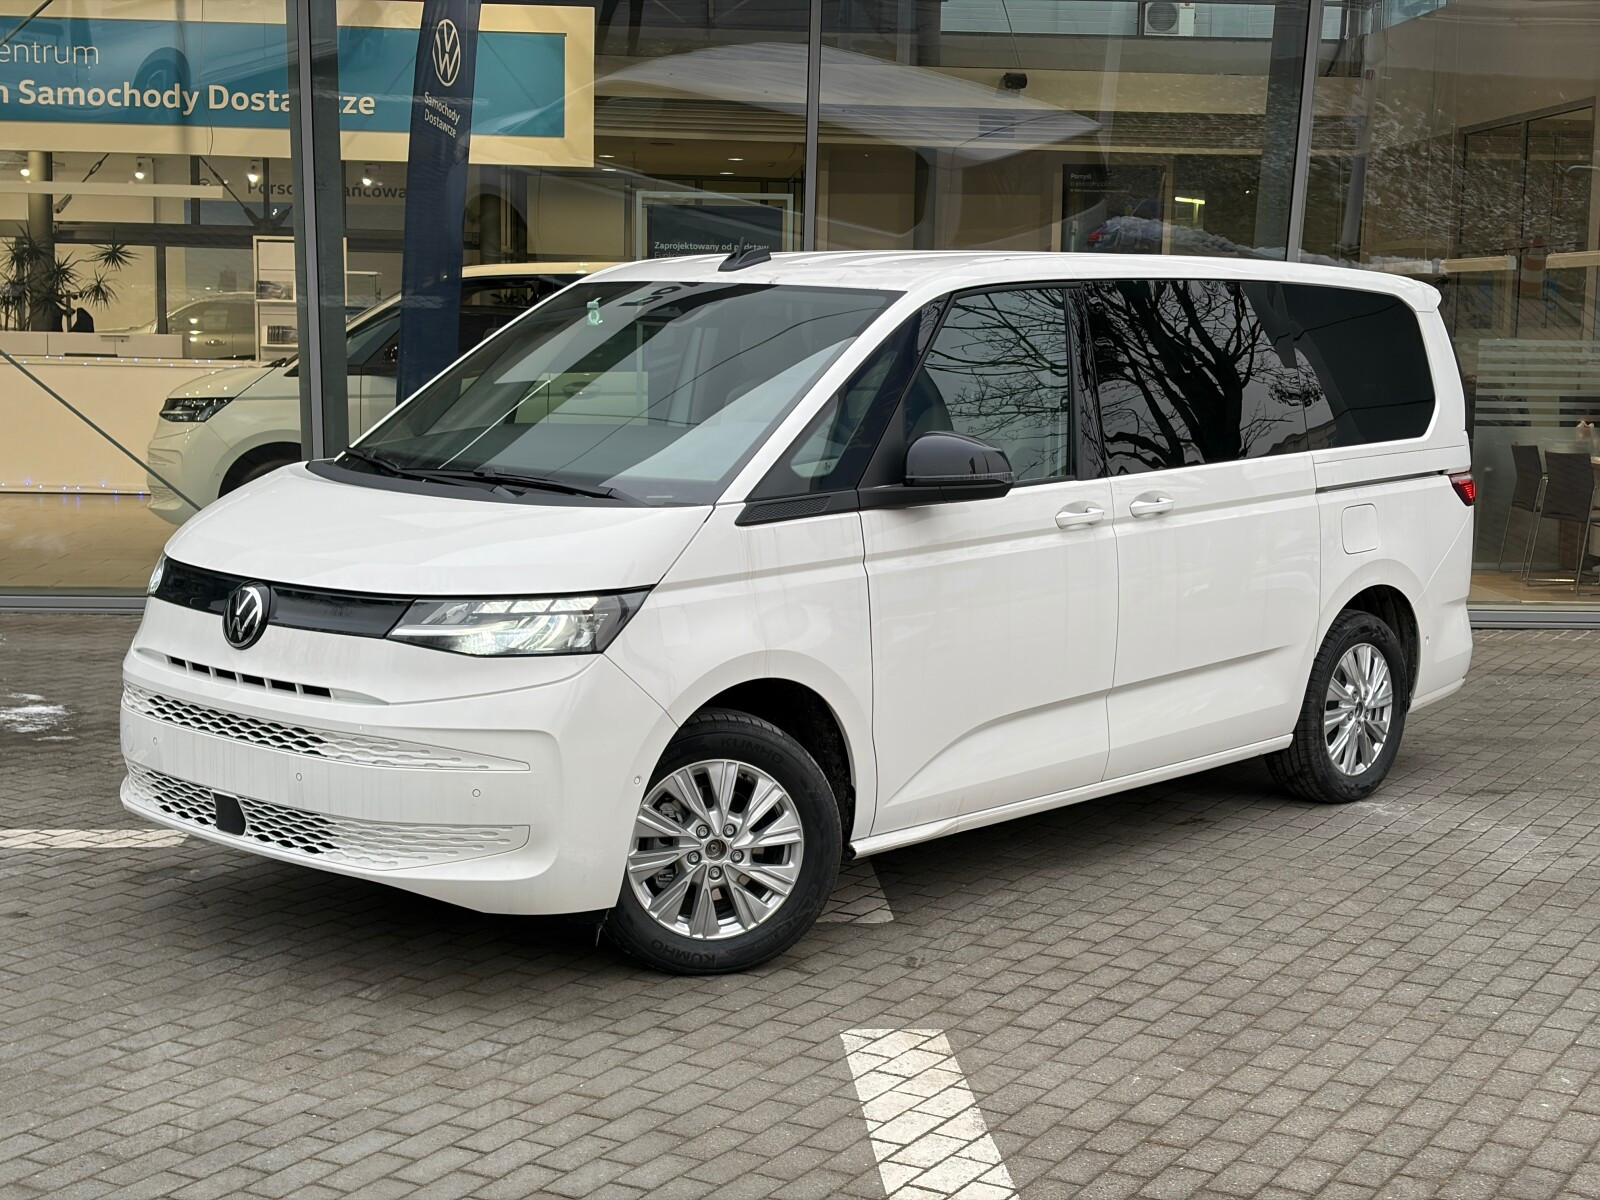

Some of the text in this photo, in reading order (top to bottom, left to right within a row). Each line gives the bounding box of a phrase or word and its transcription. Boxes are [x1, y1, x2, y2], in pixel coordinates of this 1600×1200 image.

[19, 79, 200, 116] Samochody
[425, 91, 460, 125] Samochody
[424, 108, 457, 138] Dostawcze
[654, 241, 719, 252] Zaprojektowany
[721, 243, 732, 251] od
[720, 736, 784, 764] KUMHO
[651, 939, 718, 962] KUMHO
